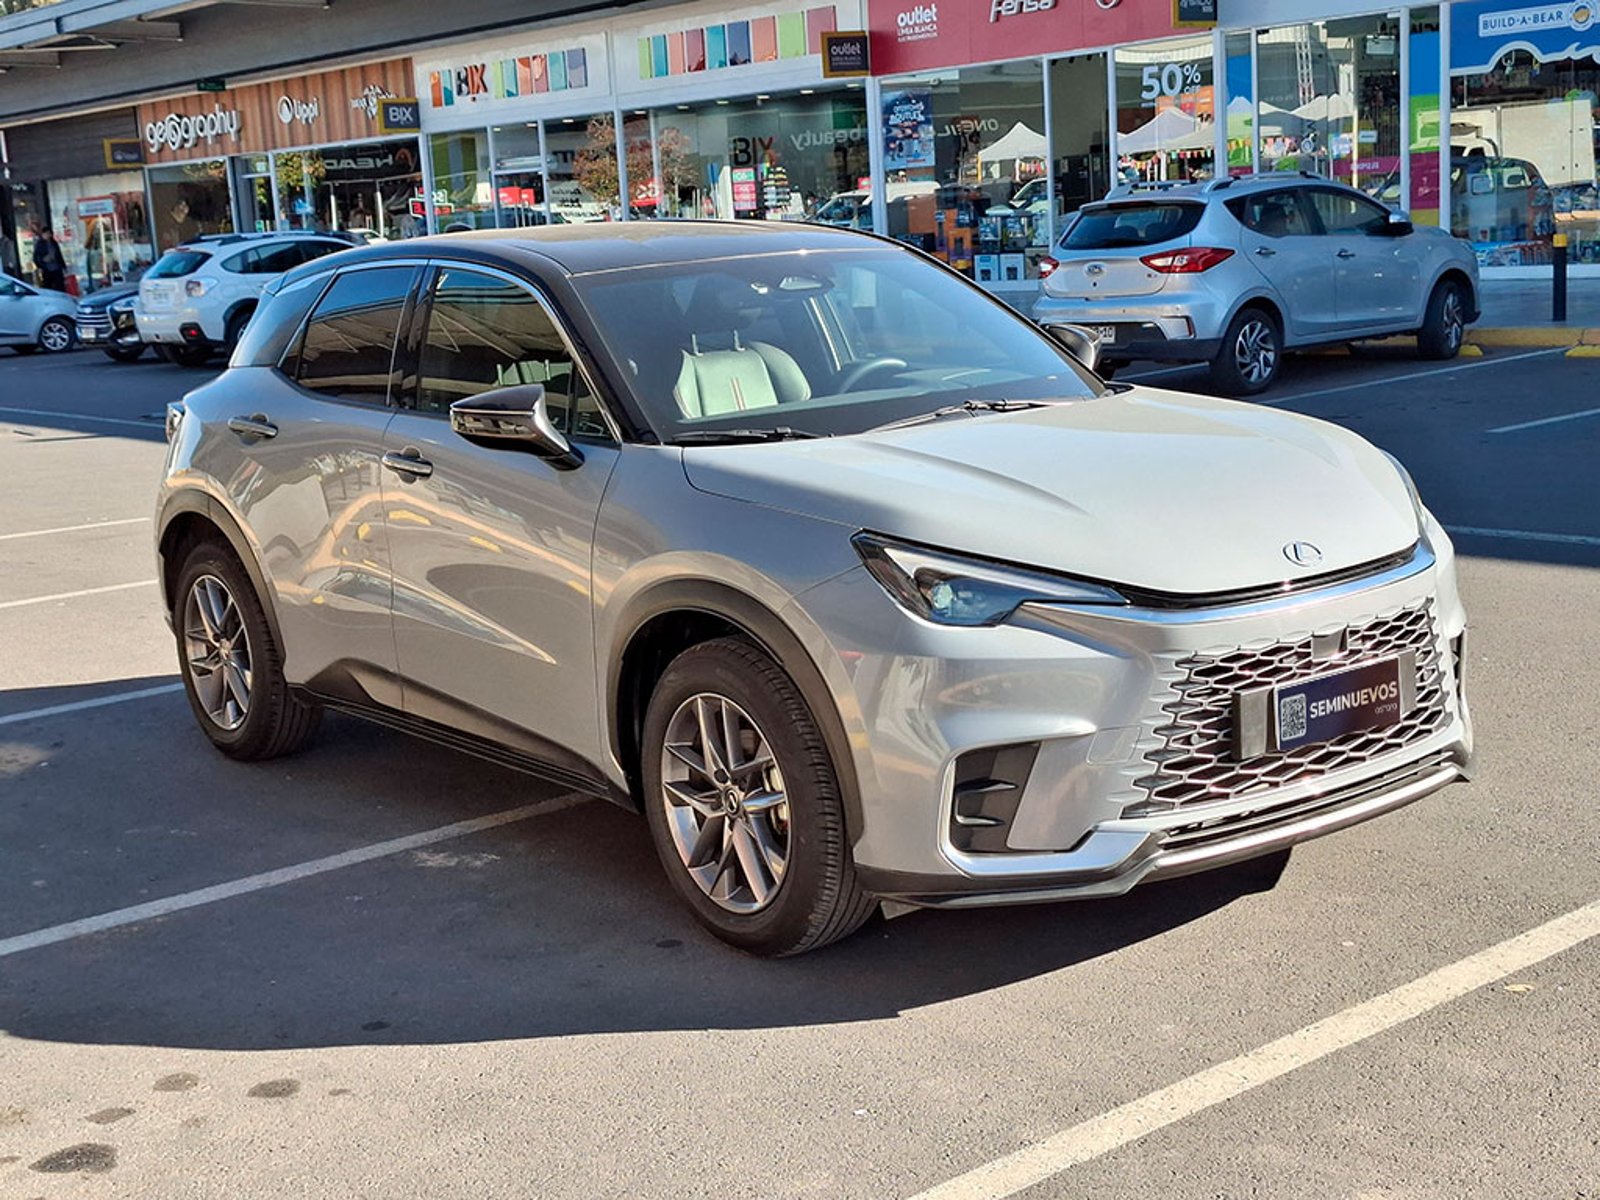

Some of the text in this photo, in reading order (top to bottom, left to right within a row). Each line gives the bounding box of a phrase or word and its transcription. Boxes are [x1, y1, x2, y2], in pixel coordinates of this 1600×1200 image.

[897, 3, 937, 27] outlet
[830, 42, 861, 55] outlet
[1141, 63, 1201, 100] 50%
[388, 106, 413, 123] BIX
[1310, 681, 1398, 719] SEMINUEVOS
